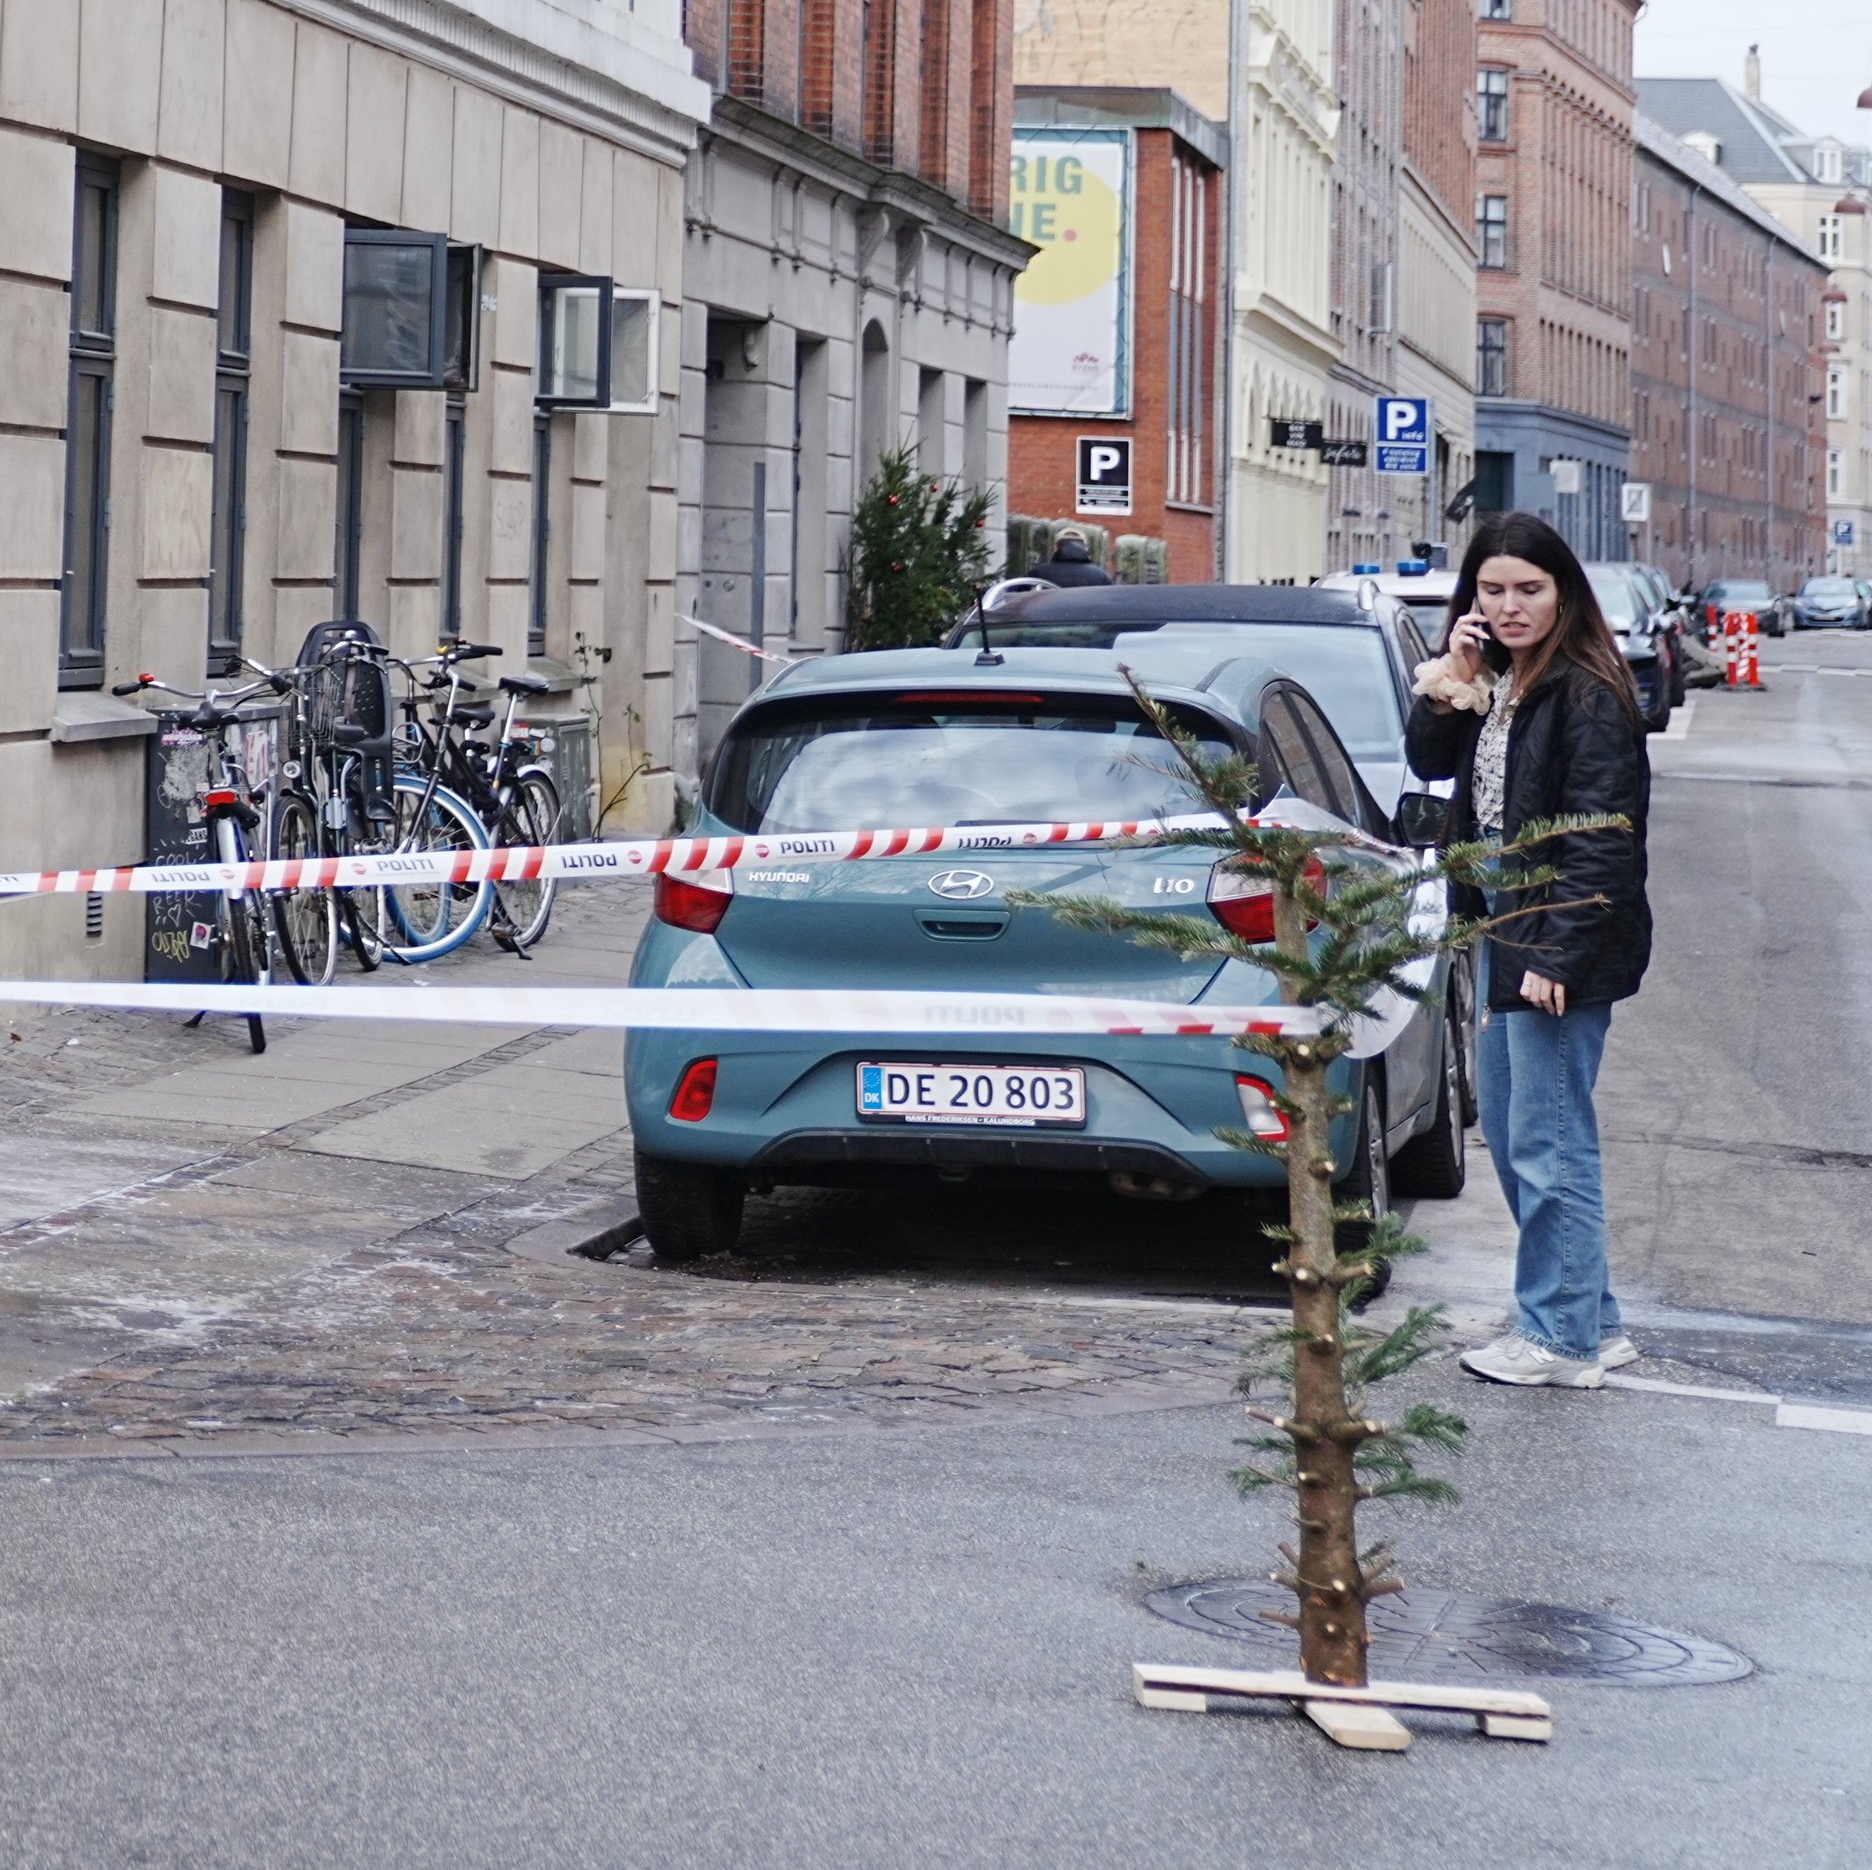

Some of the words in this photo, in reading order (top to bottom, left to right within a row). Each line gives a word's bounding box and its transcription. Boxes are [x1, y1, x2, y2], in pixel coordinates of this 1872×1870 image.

[1387, 401, 1417, 440] P
[1090, 446, 1120, 481] P
[780, 840, 835, 854] POLITI
[376, 858, 434, 872] POLITI
[561, 853, 617, 868] POLITI
[151, 871, 211, 883] POLITI
[749, 872, 809, 883] HYUNDAI
[864, 1093, 880, 1103] DK
[887, 1073, 936, 1106] DE
[949, 1075, 994, 1107] 20
[1006, 1077, 1074, 1110] 803
[927, 1115, 978, 1124] FREDERIKSEN
[984, 1117, 1035, 1126] KALUNDBORG
